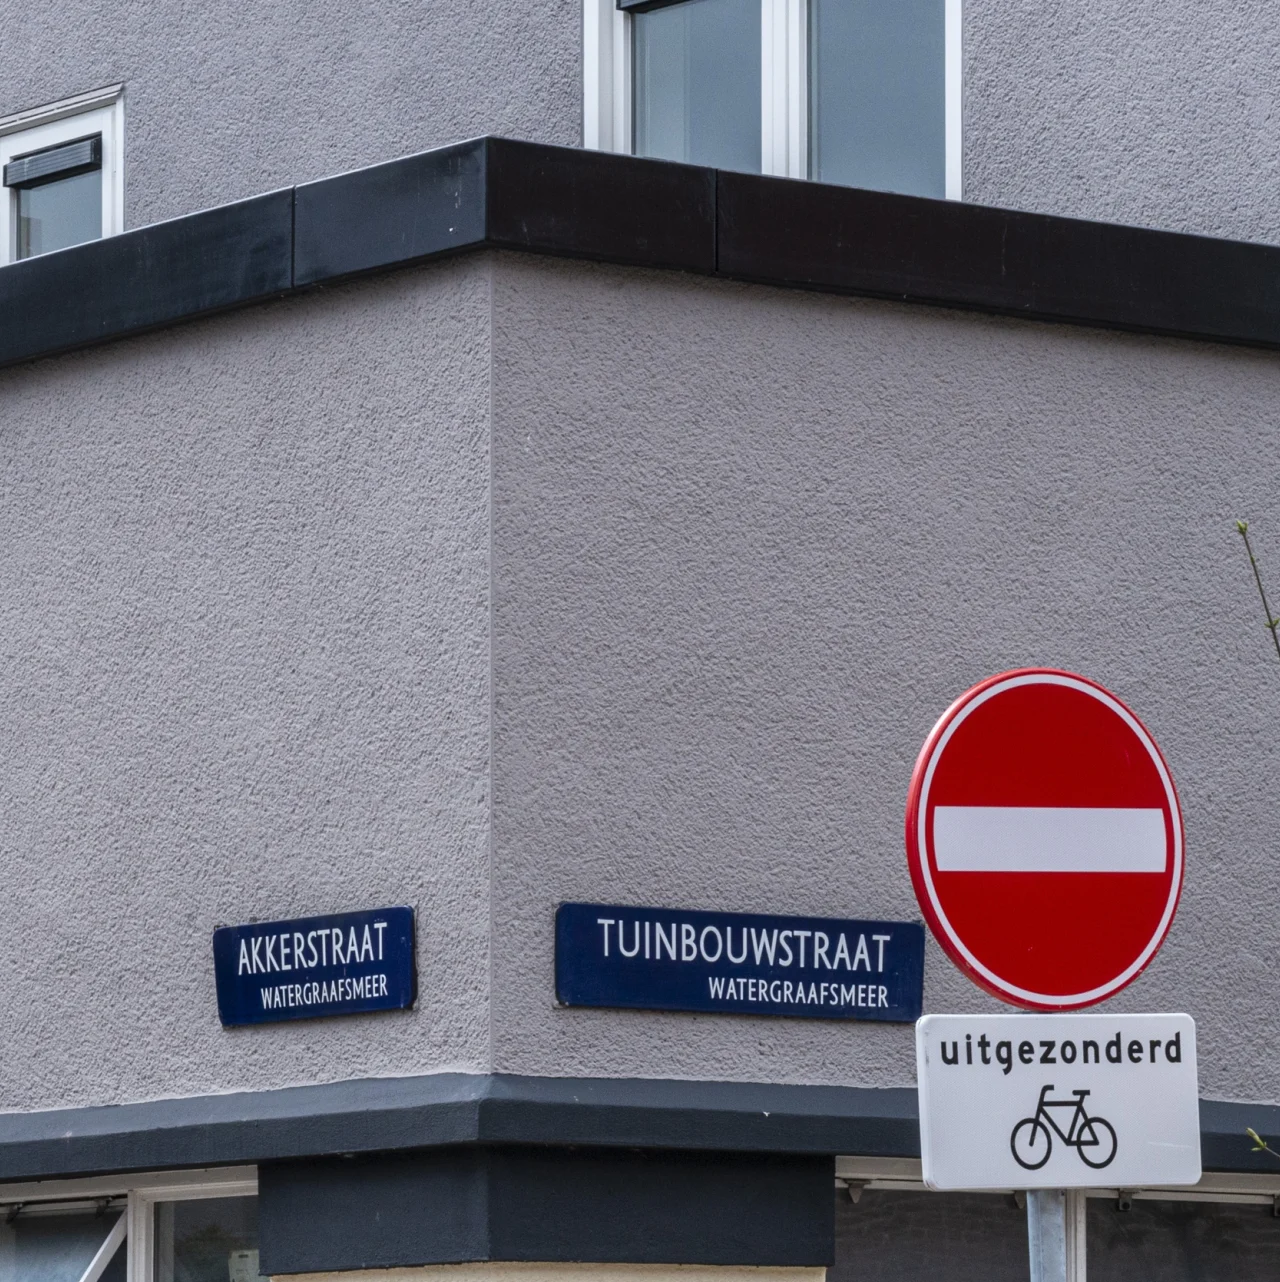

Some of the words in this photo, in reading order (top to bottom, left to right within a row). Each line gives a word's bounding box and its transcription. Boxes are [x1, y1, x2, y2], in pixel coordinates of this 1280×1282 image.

[238, 922, 387, 975] AKKERSTRAAT
[597, 918, 891, 972] TUINBOUWSTRAAT
[261, 974, 388, 1009] WATERGRAAFSMEER
[708, 976, 889, 1008] WATERGRAAFSMEER
[941, 1031, 1181, 1075] uitgezonderd
